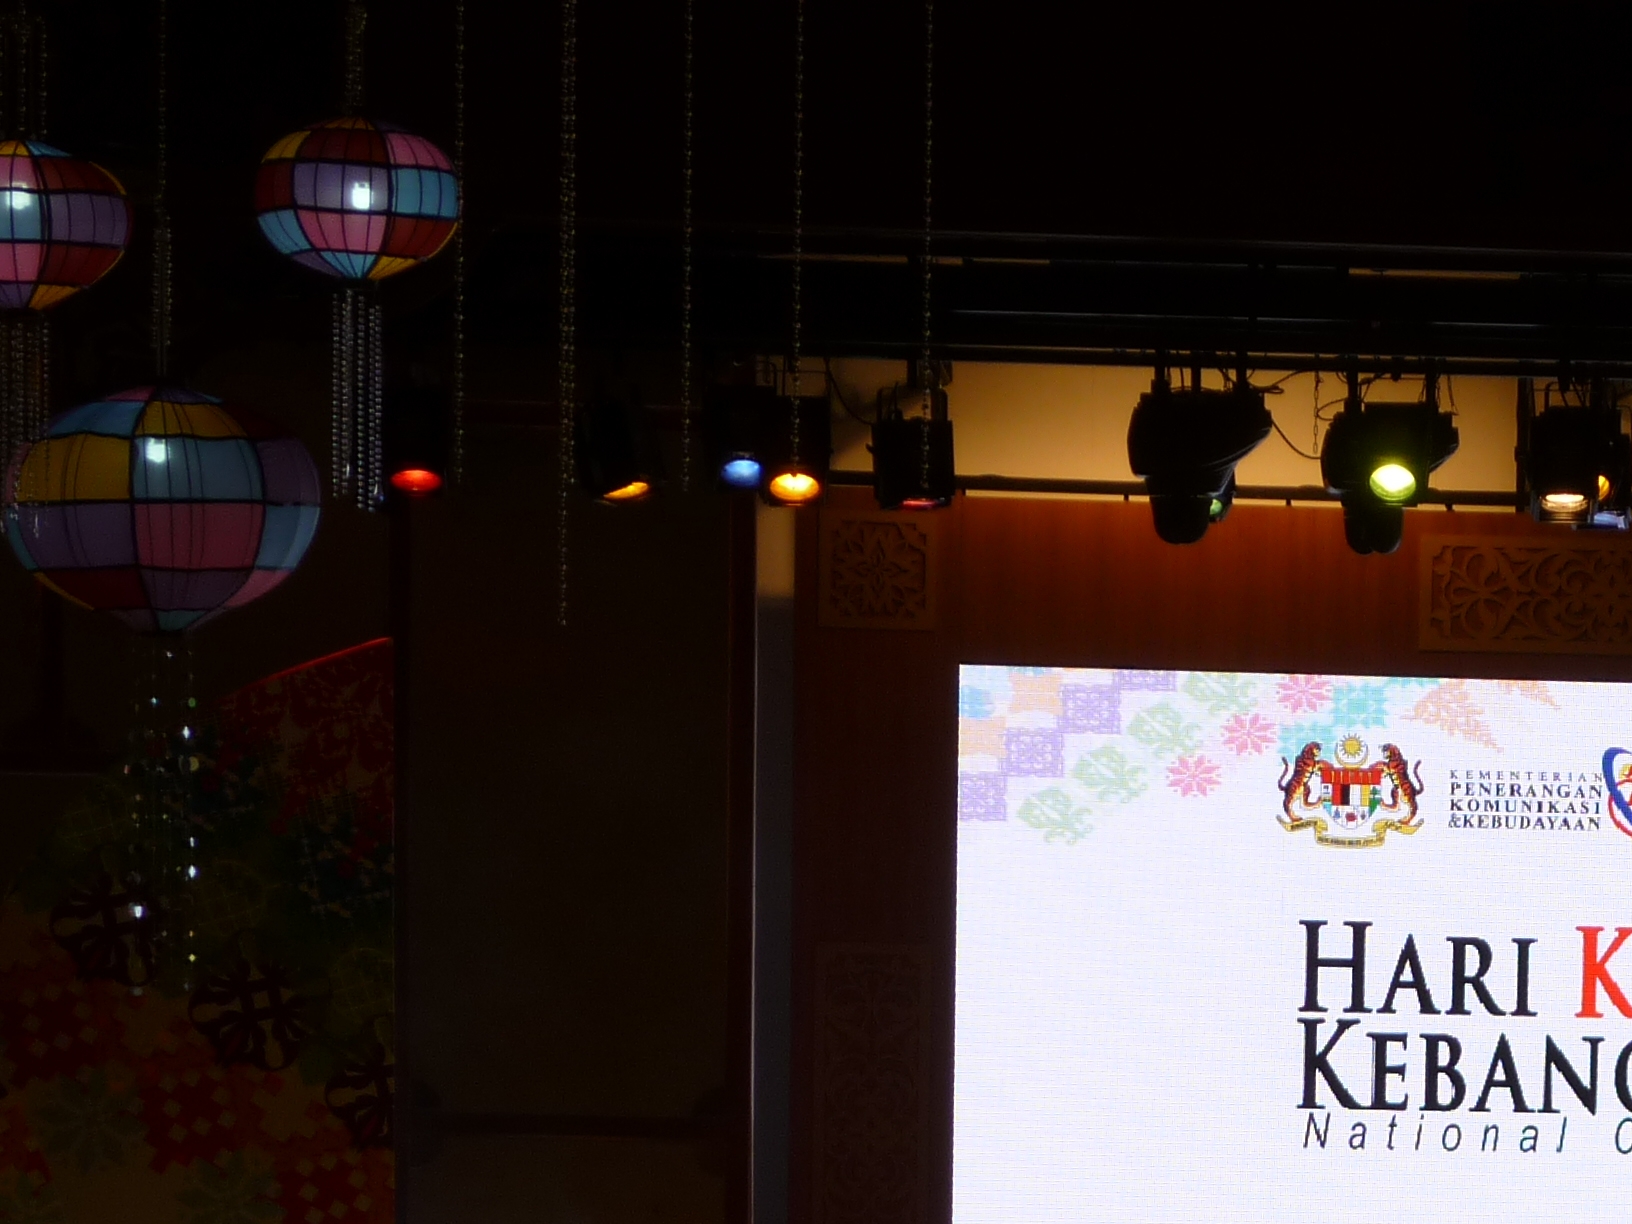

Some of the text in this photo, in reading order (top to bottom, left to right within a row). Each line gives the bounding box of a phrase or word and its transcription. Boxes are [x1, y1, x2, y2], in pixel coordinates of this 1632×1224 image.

[1449, 769, 1603, 782] KEMENTERIAN
[1449, 781, 1603, 799] PENERANGAN
[1449, 799, 1601, 814] KOMUNIKASI
[1448, 813, 1601, 830] &KEBUDAYAAN
[1298, 919, 1539, 1017] HARI
[1303, 1113, 1568, 1153] National
